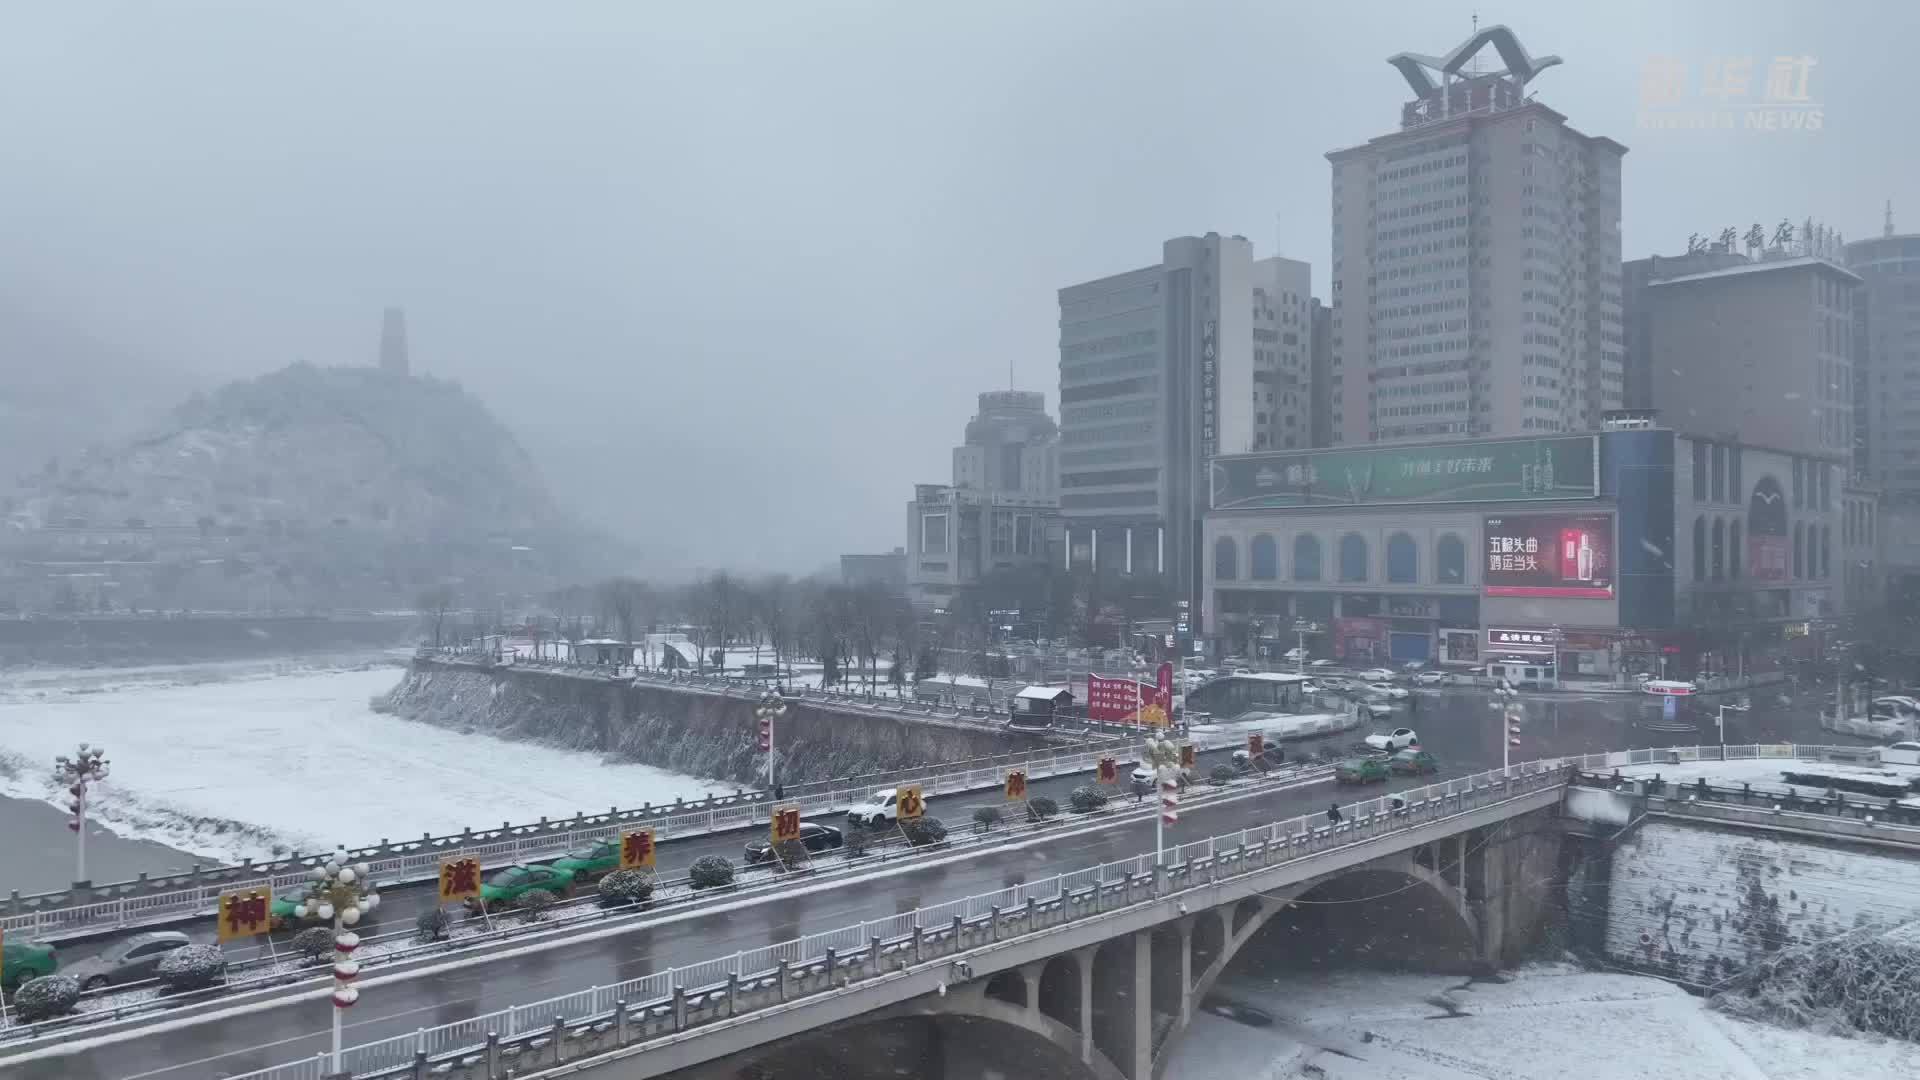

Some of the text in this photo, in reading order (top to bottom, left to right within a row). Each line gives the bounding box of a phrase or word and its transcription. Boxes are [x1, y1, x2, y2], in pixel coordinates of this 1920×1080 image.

[1489, 554, 1538, 571] 鸿运当头
[902, 789, 920, 814] 心
[775, 807, 798, 837] 初
[623, 831, 651, 864] 养
[443, 857, 478, 896] 滋
[225, 891, 267, 934] 神
